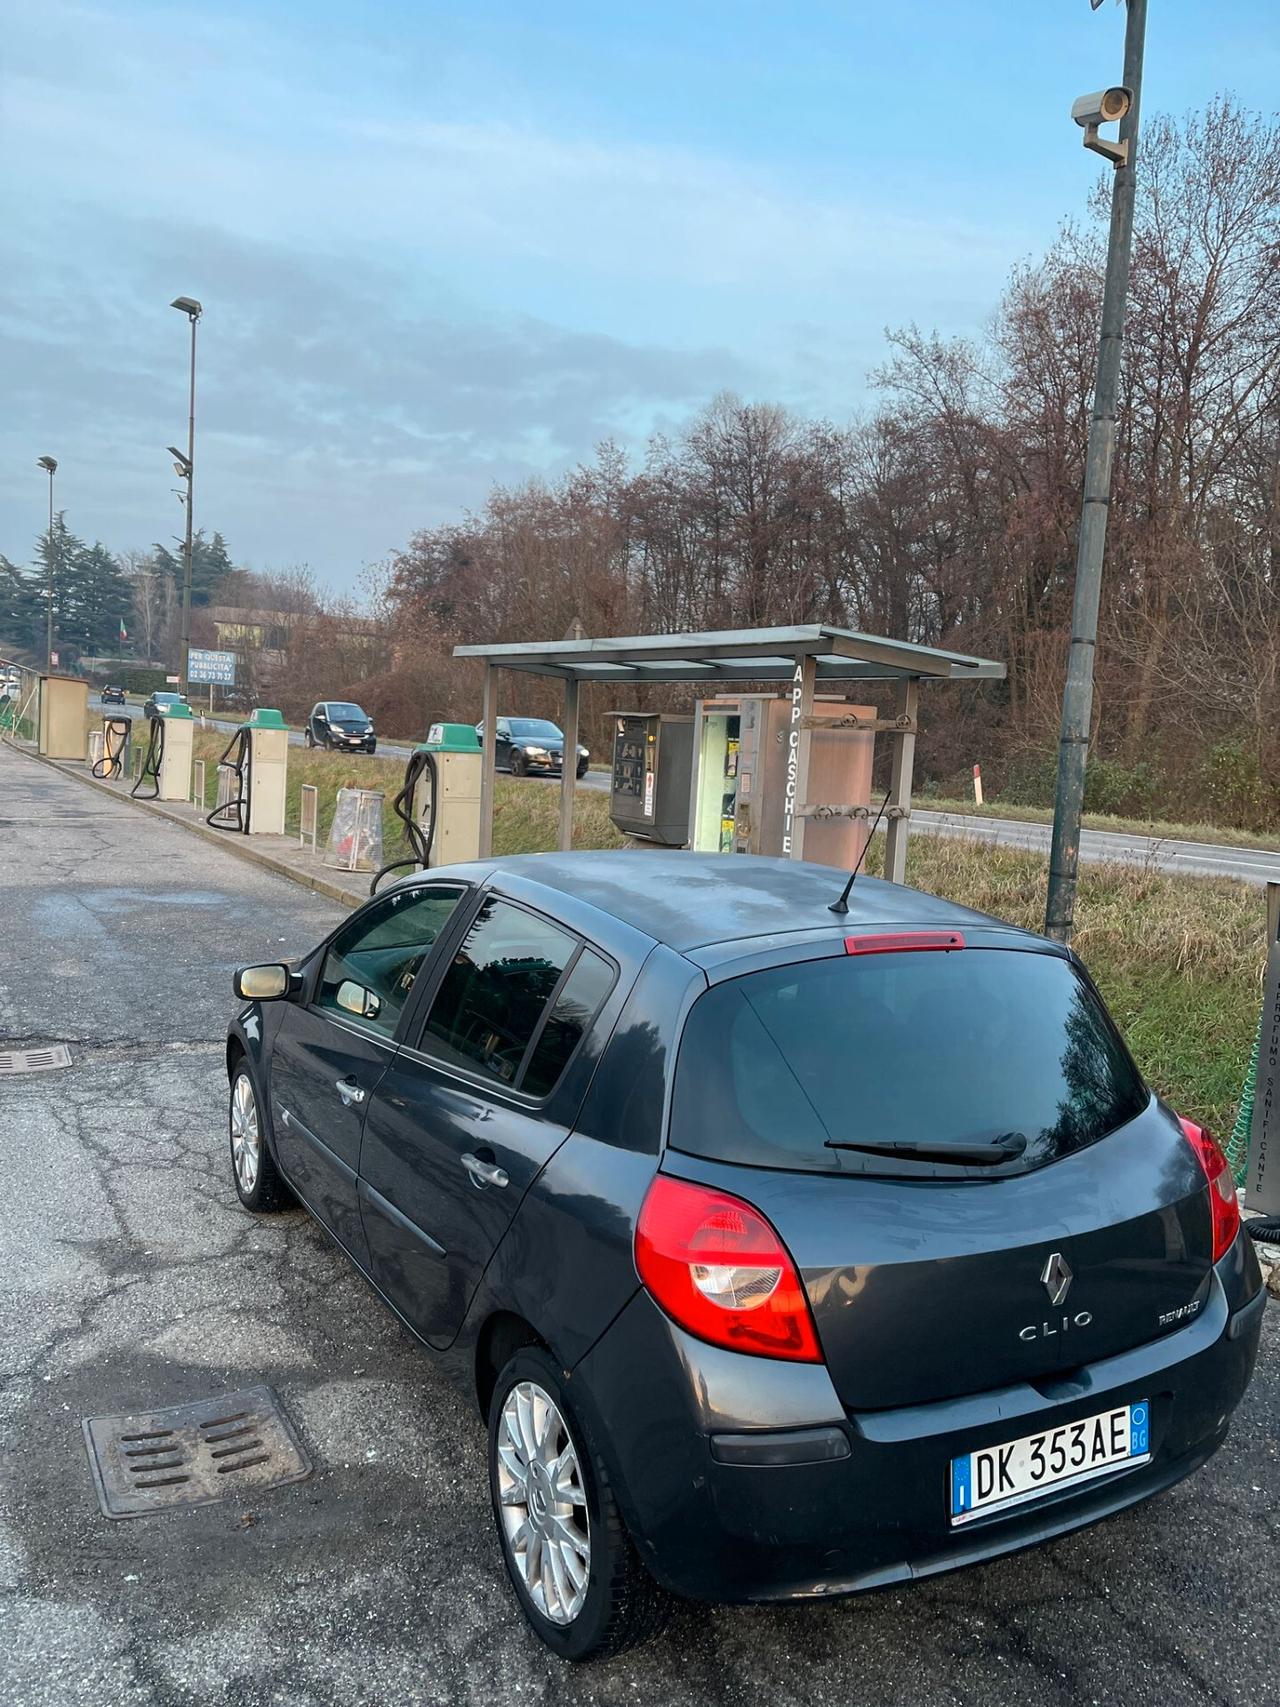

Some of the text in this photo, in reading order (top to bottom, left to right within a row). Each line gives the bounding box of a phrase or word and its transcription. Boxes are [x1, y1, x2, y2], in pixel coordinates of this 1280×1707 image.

[190, 670, 198, 678] 02
[1256, 1077, 1274, 1193] SANIFICANTE
[1018, 1310, 1093, 1342] CLIO
[976, 1444, 1016, 1501] DK
[1029, 1409, 1127, 1482] 353AE
[1131, 1431, 1146, 1449] BG
